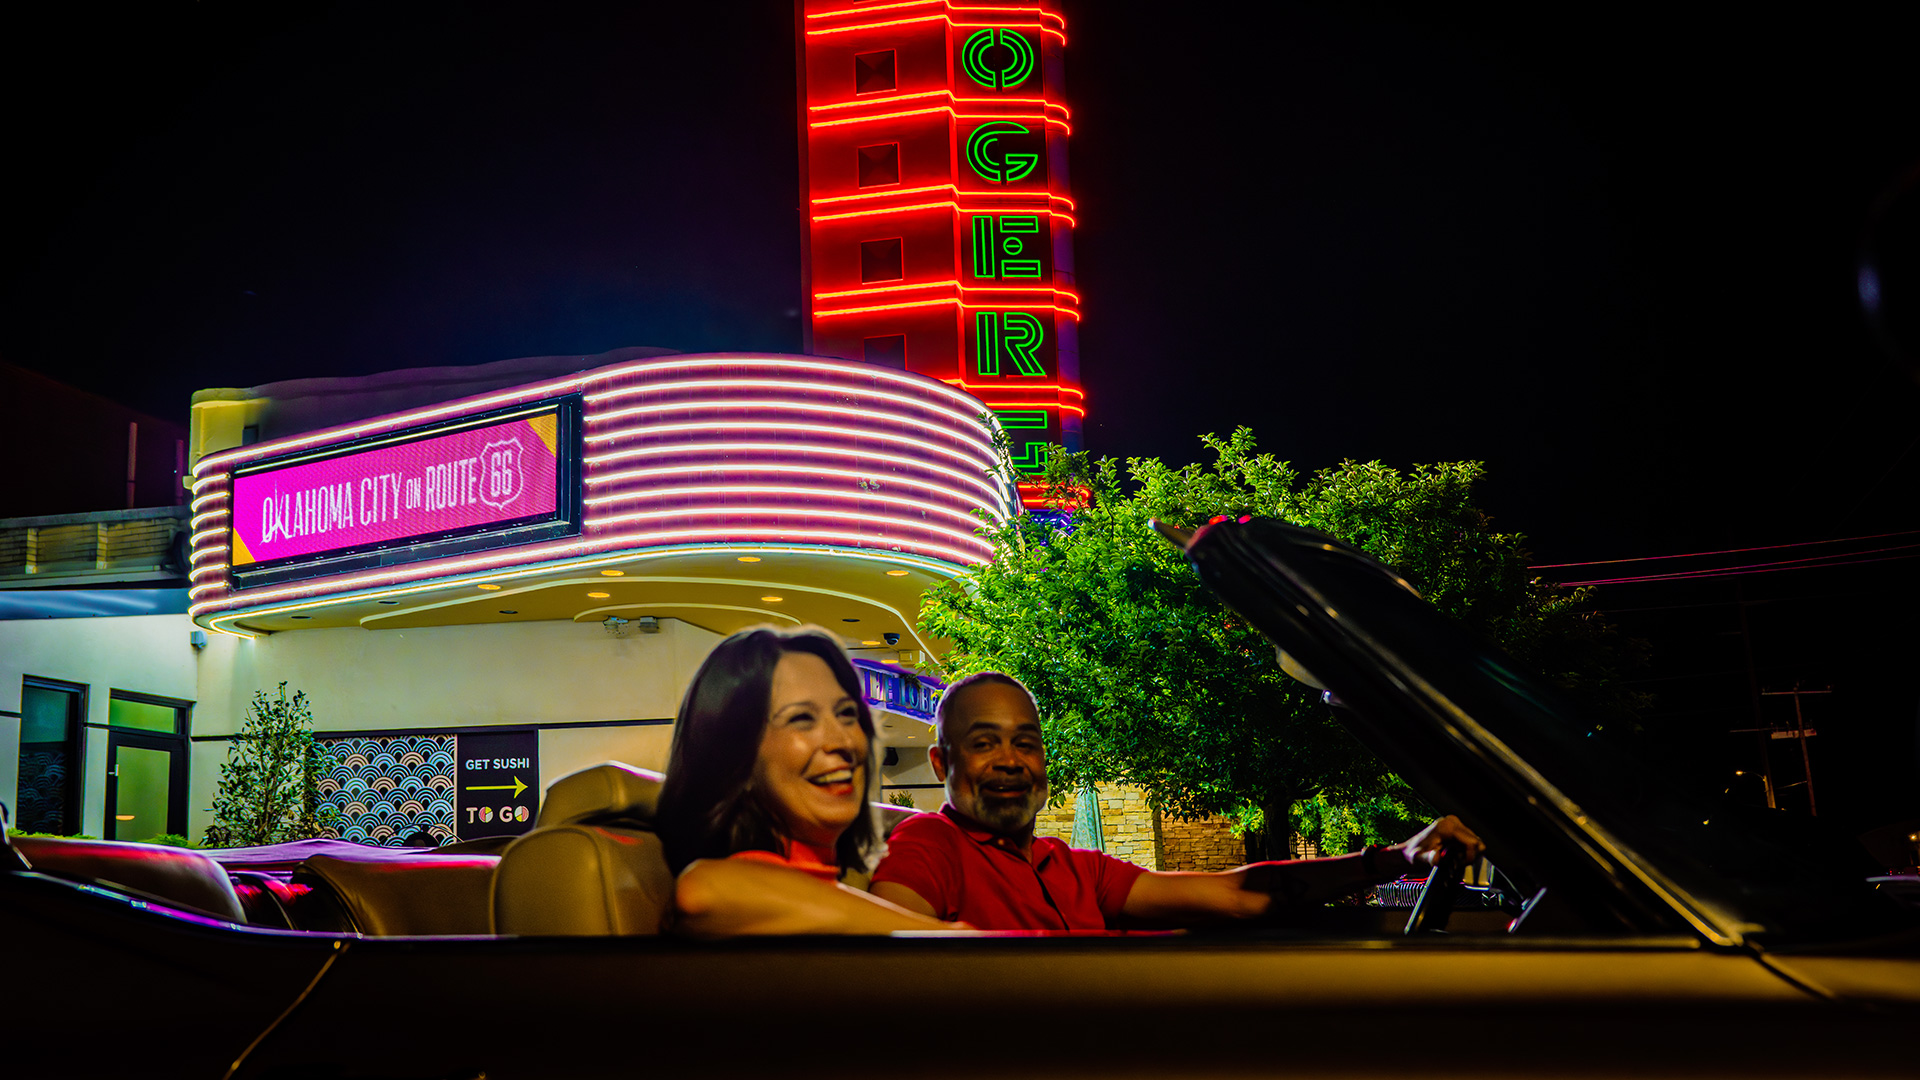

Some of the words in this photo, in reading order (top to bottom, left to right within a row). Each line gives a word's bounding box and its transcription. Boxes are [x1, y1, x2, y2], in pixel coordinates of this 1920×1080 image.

[260, 478, 354, 545] OKLAHOMA
[360, 472, 402, 526] CITY
[406, 477, 421, 509] ON
[425, 457, 477, 512] ROUTE
[491, 449, 513, 498] 66
[465, 759, 490, 770] GET
[493, 757, 530, 769] SUSHI
[465, 806, 494, 824] TO
[499, 805, 530, 823] GO
